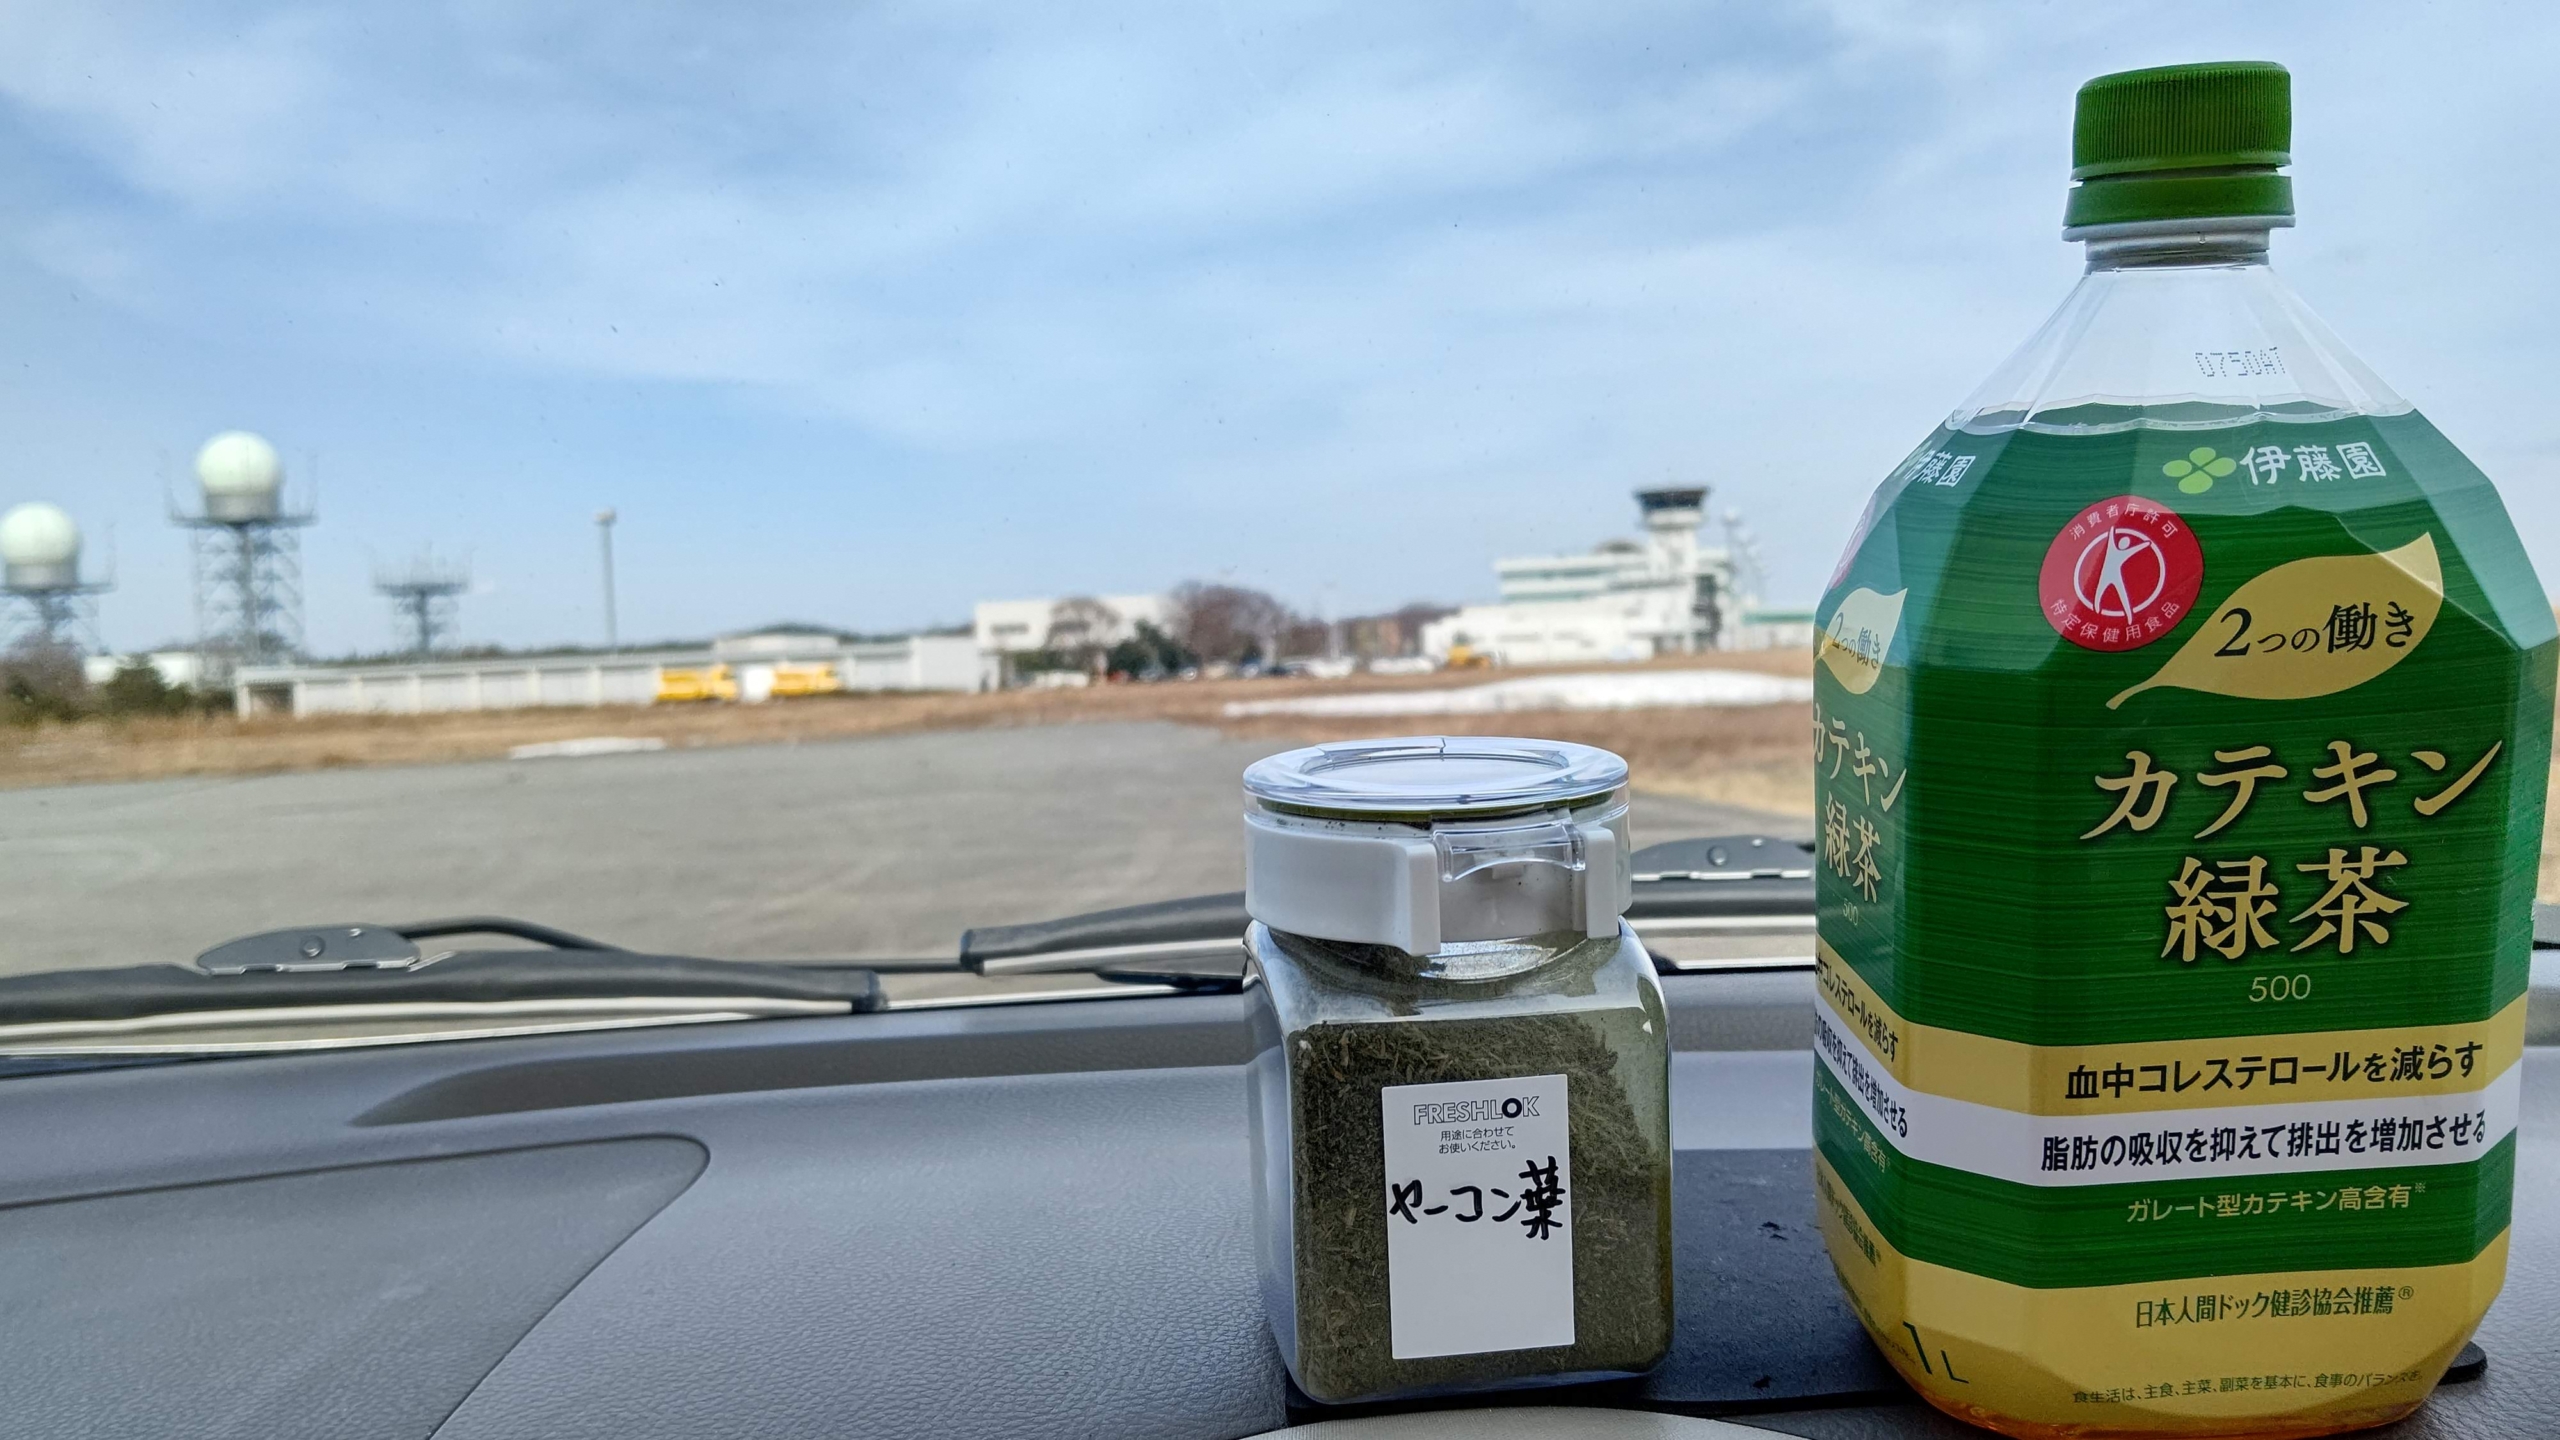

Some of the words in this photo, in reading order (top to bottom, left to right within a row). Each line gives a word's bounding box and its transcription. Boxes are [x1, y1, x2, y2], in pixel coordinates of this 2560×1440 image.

[2240, 441, 2387, 487] 伊藤園
[2069, 503, 2178, 540] 消費者庁許可
[1832, 611, 1881, 670] 2つの働き
[2050, 599, 2180, 643] 特定保健用食品
[2214, 601, 2419, 660] 2つの働き
[1813, 702, 1907, 813] カテキン
[2079, 739, 2503, 841] カテキン
[1825, 790, 1882, 903] 緑茶
[1842, 898, 1859, 926] 500
[2160, 845, 2410, 962] 緑茶
[1815, 952, 1898, 1062] 中コレステロールを減らす
[2247, 974, 2312, 1003] 500
[2065, 1040, 2484, 1100] 血中コレステロールを減らす
[1414, 1096, 1540, 1125] FRESHLOK
[1440, 1126, 1515, 1142] 用途に合わせて
[1438, 1140, 1516, 1155] お使いください。
[2040, 1109, 2488, 1173] 脂肪の吸収を抑えて排出を増加させる
